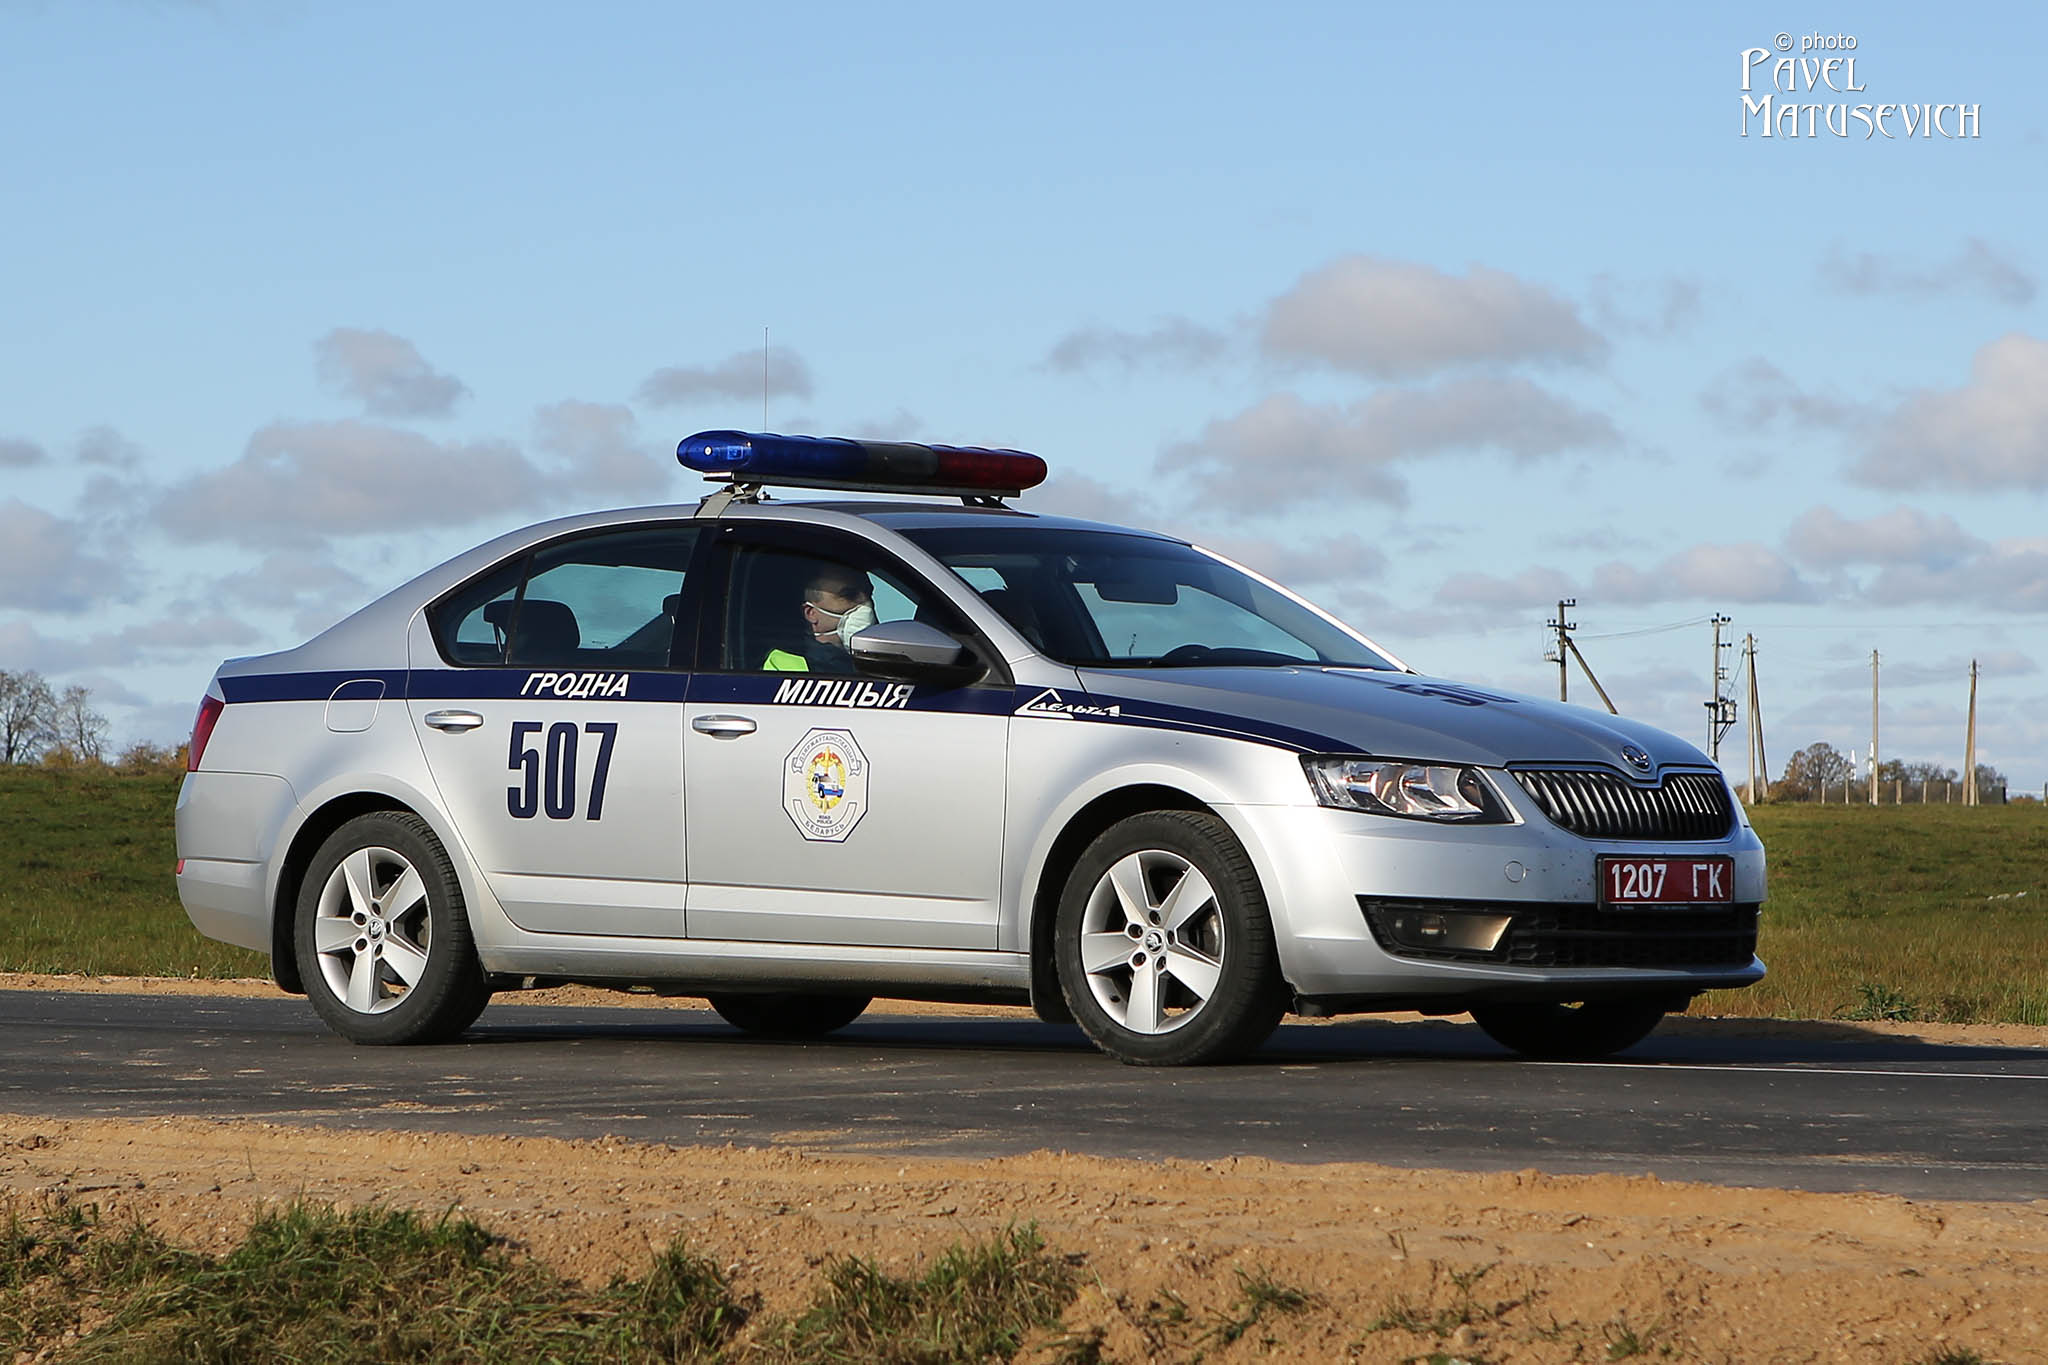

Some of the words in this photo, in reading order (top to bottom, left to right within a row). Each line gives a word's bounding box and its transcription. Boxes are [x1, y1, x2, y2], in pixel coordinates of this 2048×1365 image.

[520, 673, 630, 698] ГРОДНА
[773, 679, 915, 708] МІЛІЦЫЯ
[507, 721, 618, 820] 507
[805, 820, 845, 835] БЕЛАРУСЬ
[1611, 863, 1667, 899] 1207
[1692, 863, 1724, 899] ГК
